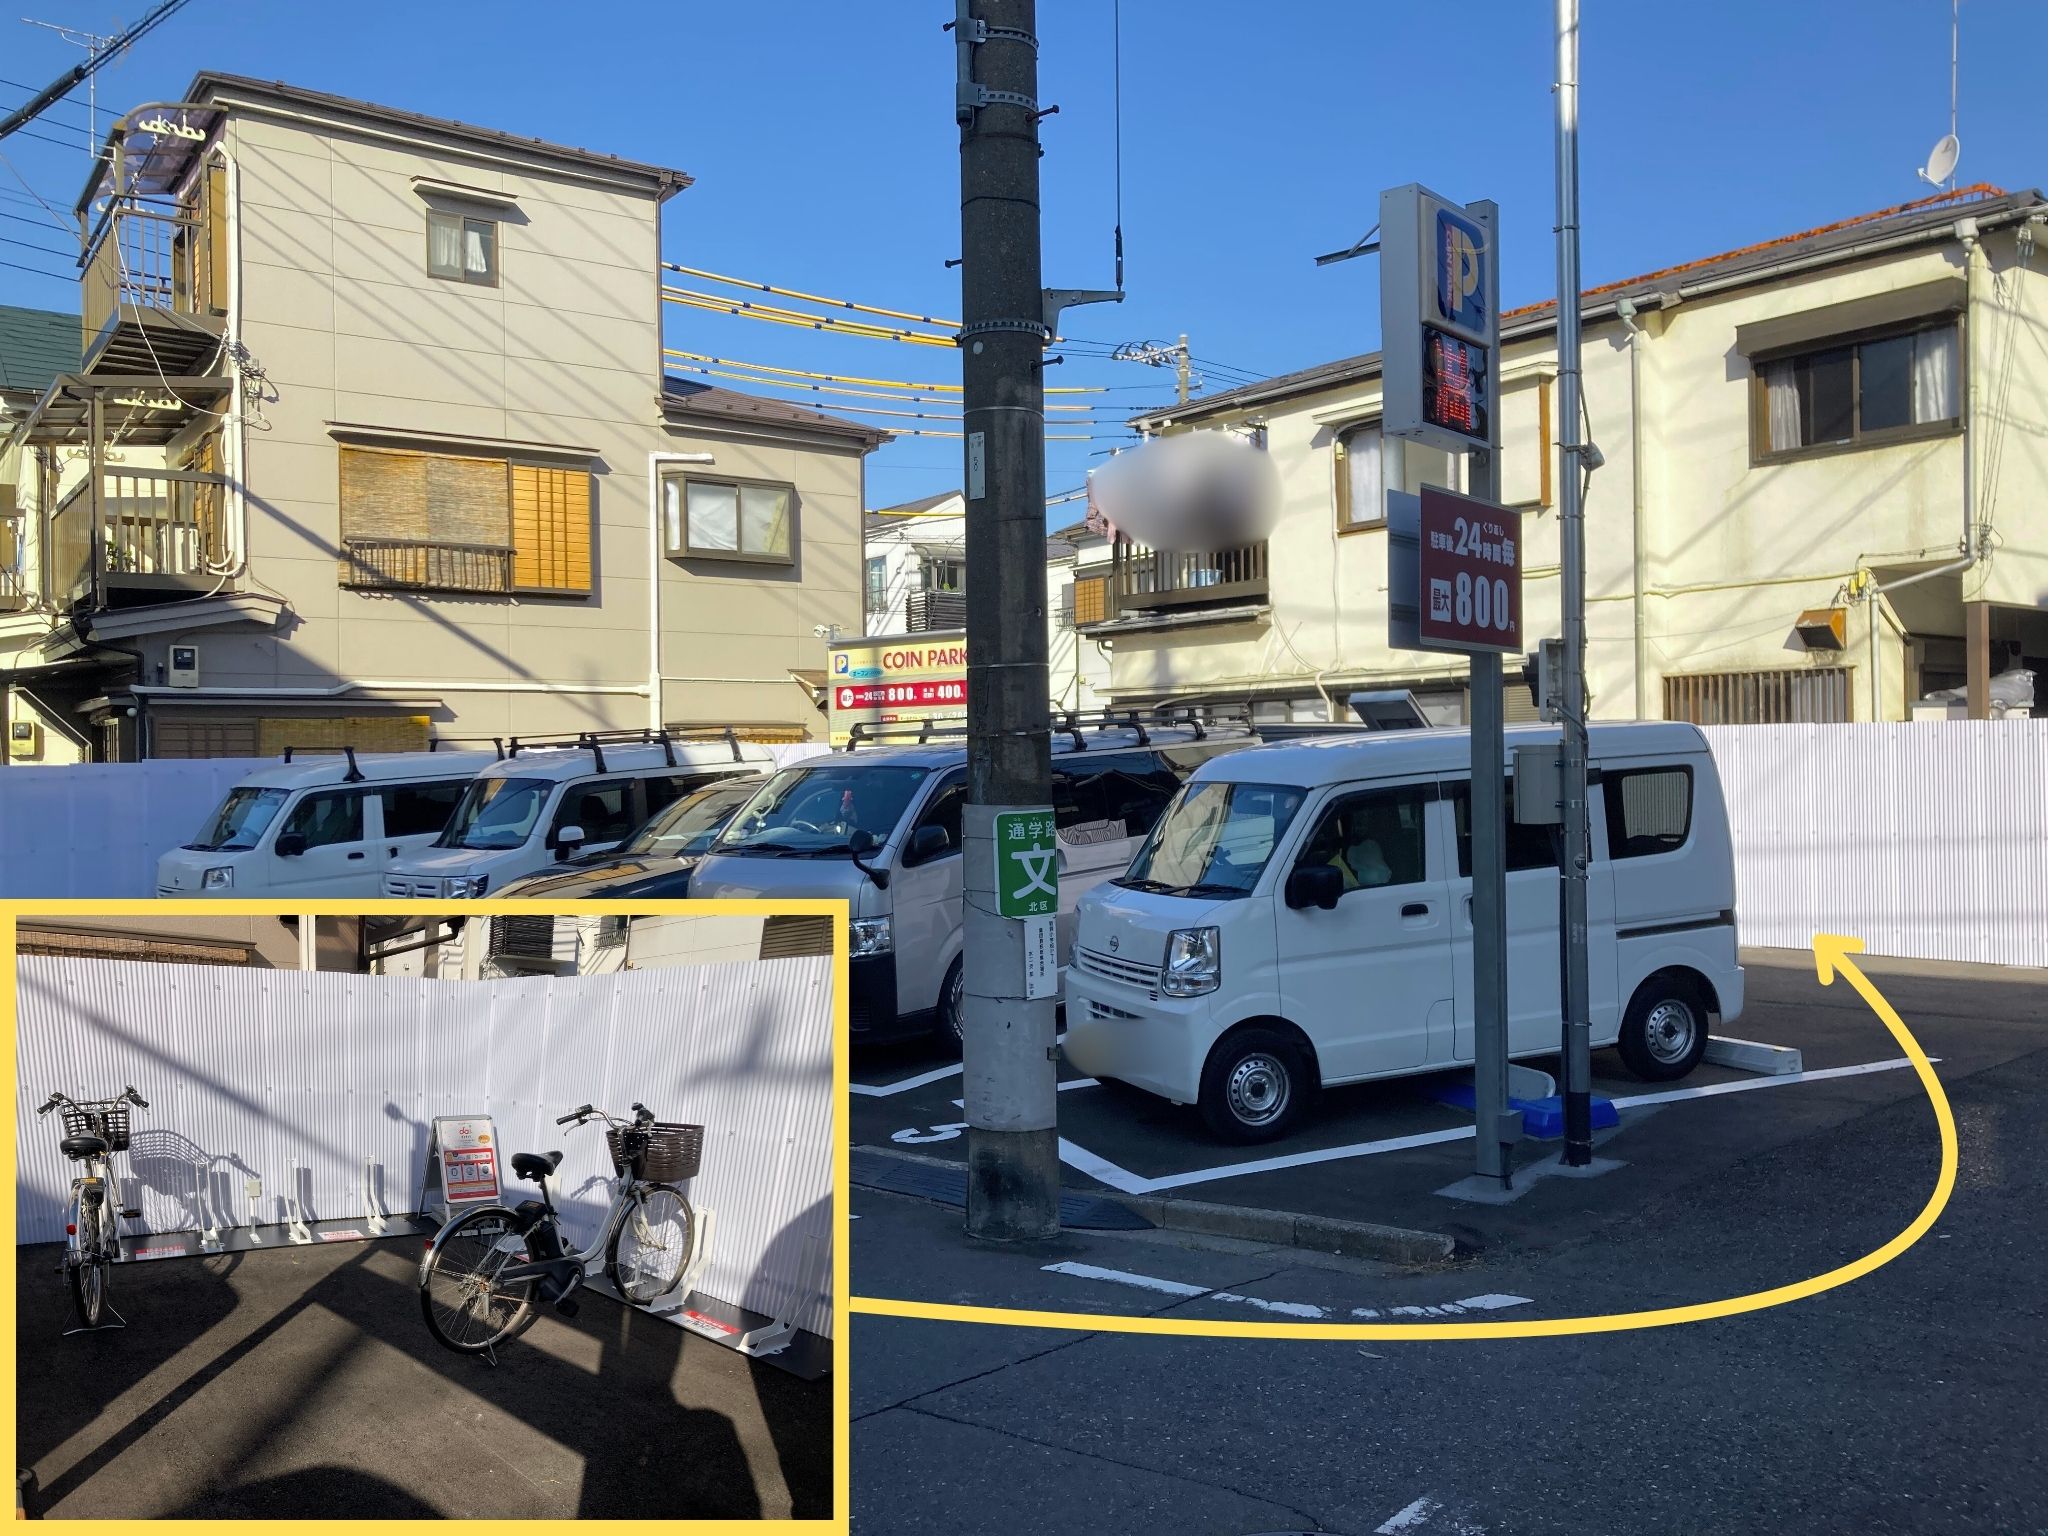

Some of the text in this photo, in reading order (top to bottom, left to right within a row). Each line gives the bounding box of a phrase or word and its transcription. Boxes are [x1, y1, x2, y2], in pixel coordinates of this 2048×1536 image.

[1433, 587, 1450, 613] 最大
[883, 650, 923, 670] COIN
[1028, 900, 1048, 912] 北区
